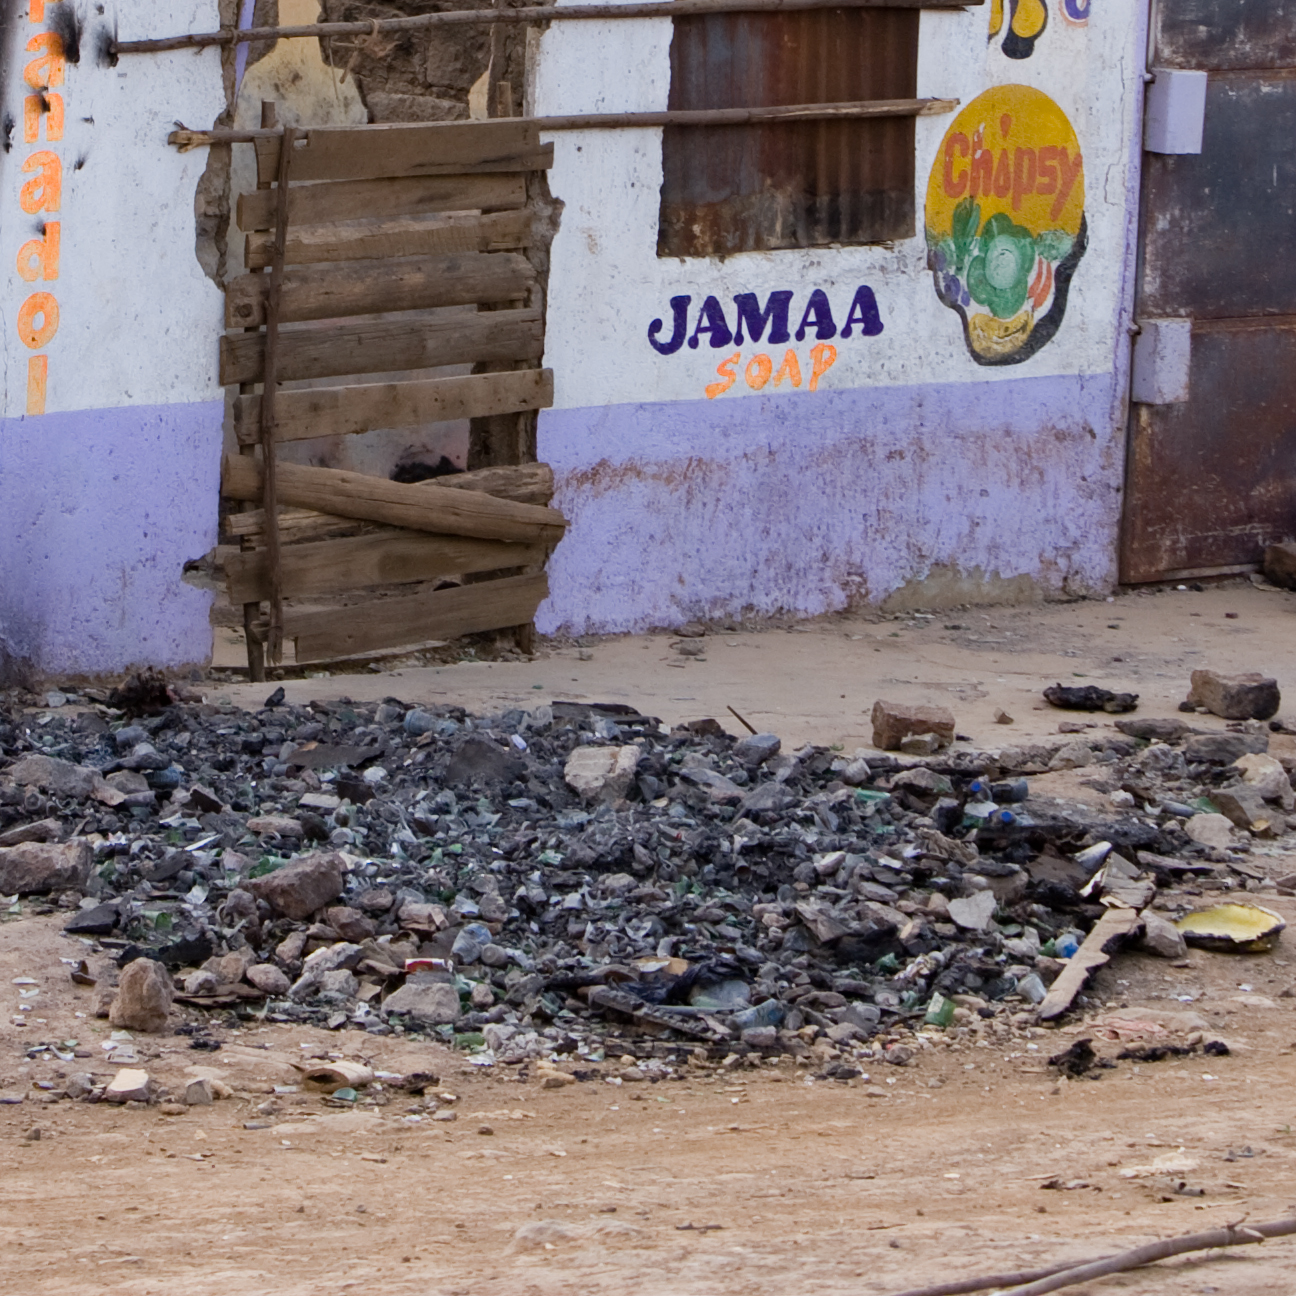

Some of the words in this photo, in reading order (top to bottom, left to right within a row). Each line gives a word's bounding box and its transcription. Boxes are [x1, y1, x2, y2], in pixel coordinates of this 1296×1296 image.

[942, 113, 1083, 221] Chipsy
[647, 285, 884, 356] JAMAA
[704, 343, 837, 400] SOAP
